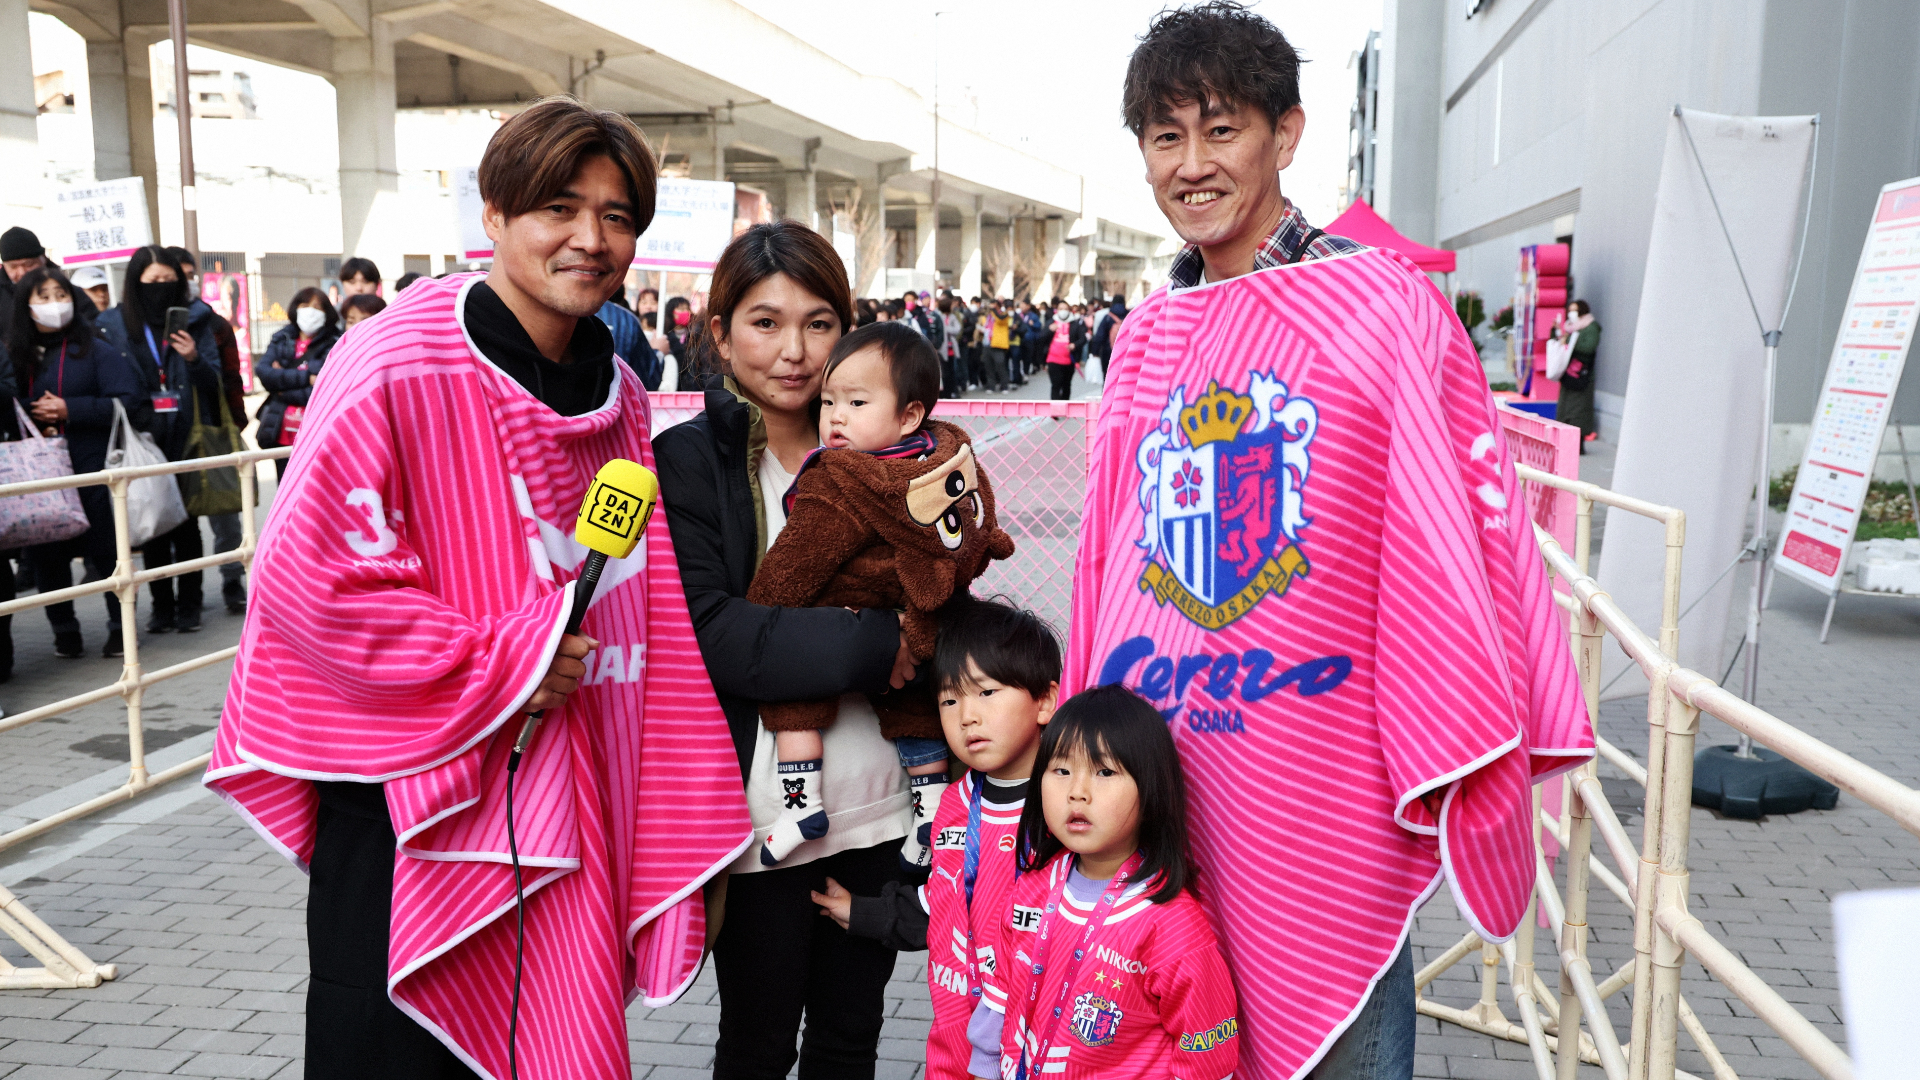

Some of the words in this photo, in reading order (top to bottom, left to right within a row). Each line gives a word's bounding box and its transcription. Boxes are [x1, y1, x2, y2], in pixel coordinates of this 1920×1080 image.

[69, 201, 126, 223] 一般入場
[76, 226, 128, 251] 最後尾
[1165, 577, 1213, 625] CEREZO
[1215, 569, 1275, 624] OSAKA
[1188, 708, 1246, 734] OSAKA
[1012, 908, 1042, 928] ヨド
